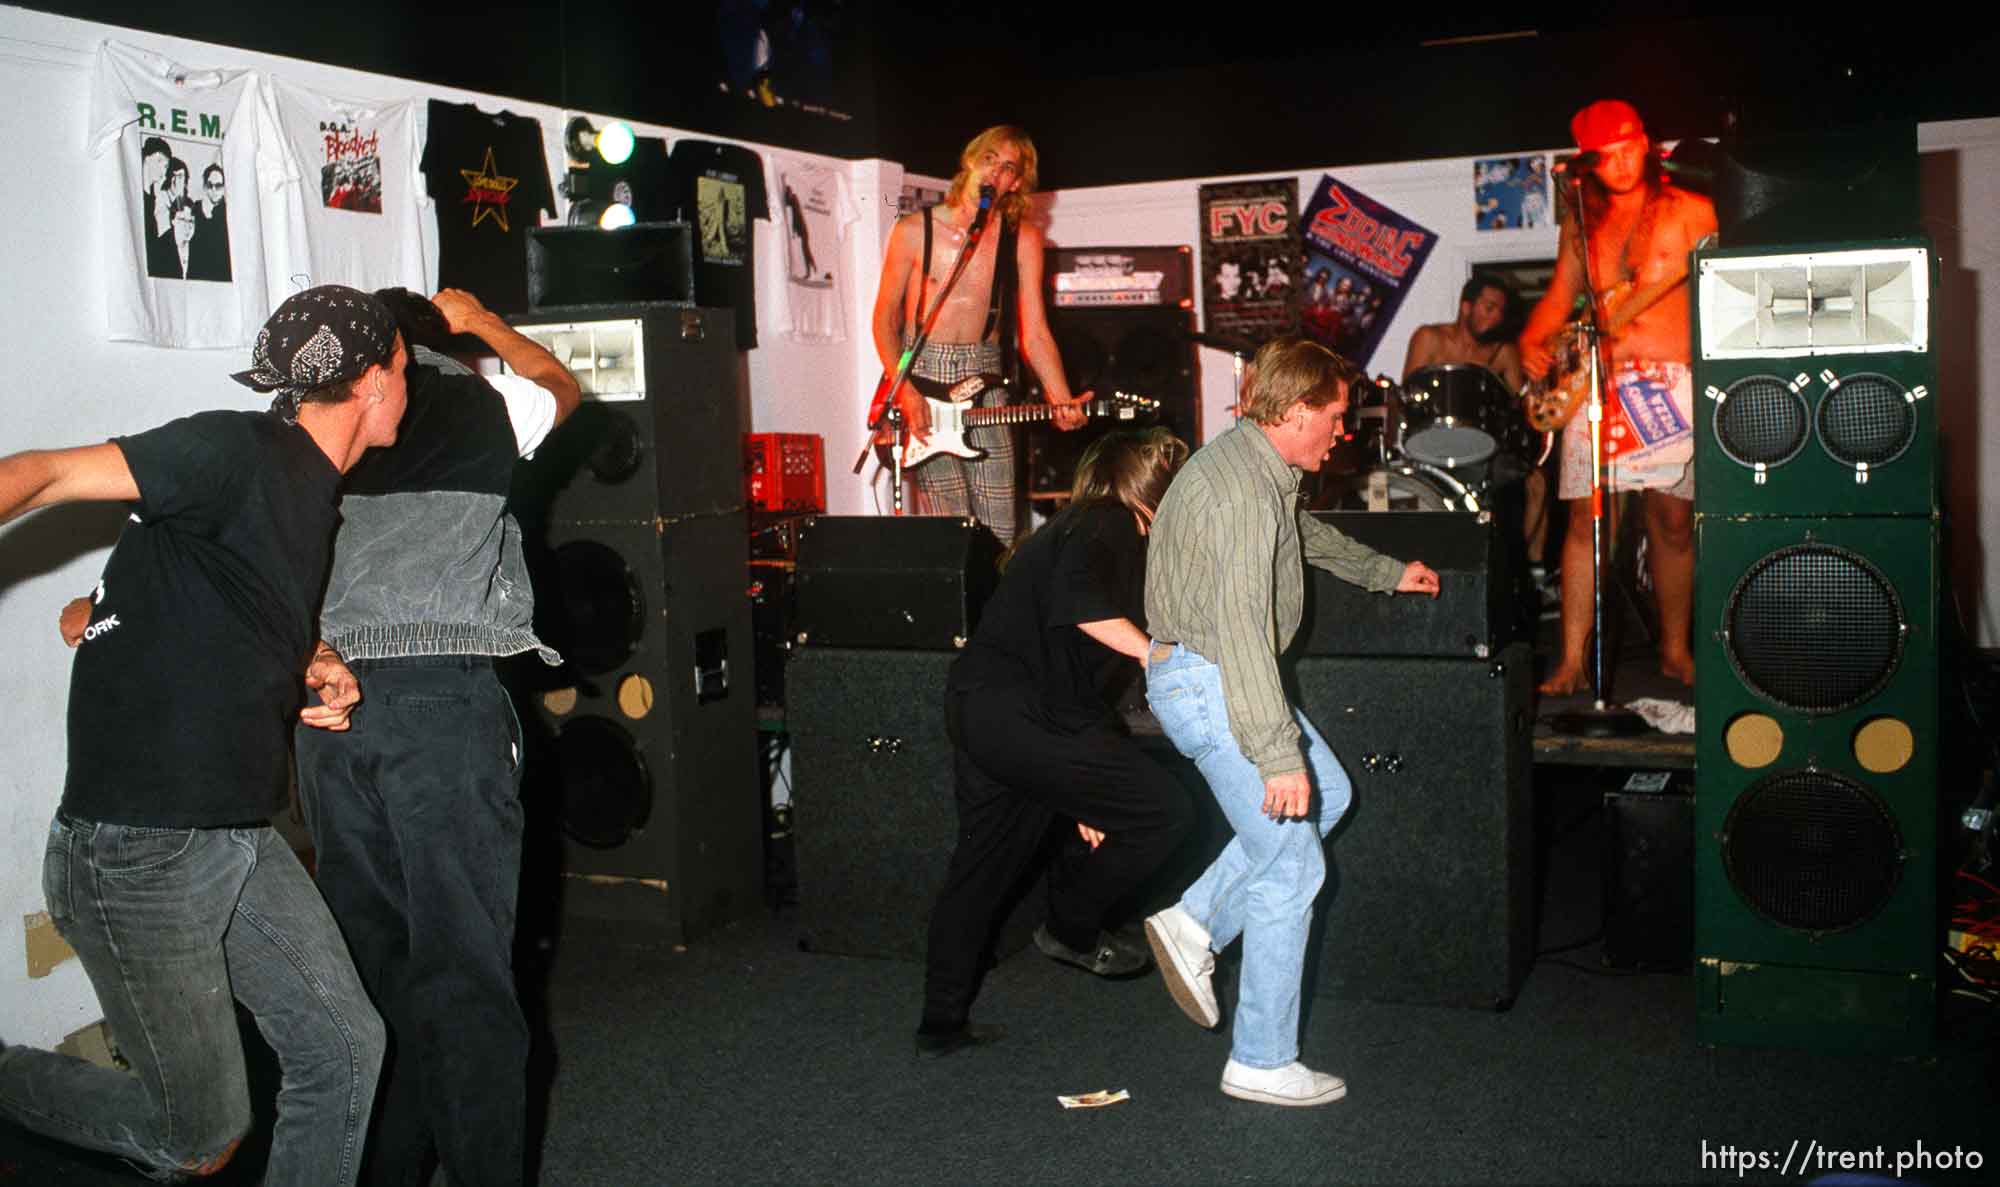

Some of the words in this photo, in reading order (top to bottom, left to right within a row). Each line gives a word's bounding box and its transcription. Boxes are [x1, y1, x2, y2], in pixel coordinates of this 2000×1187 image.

[136, 102, 226, 140] R.E.M.
[1209, 202, 1288, 238] FYC
[1315, 184, 1425, 266] ZODIAC
[84, 613, 121, 641] ORK
